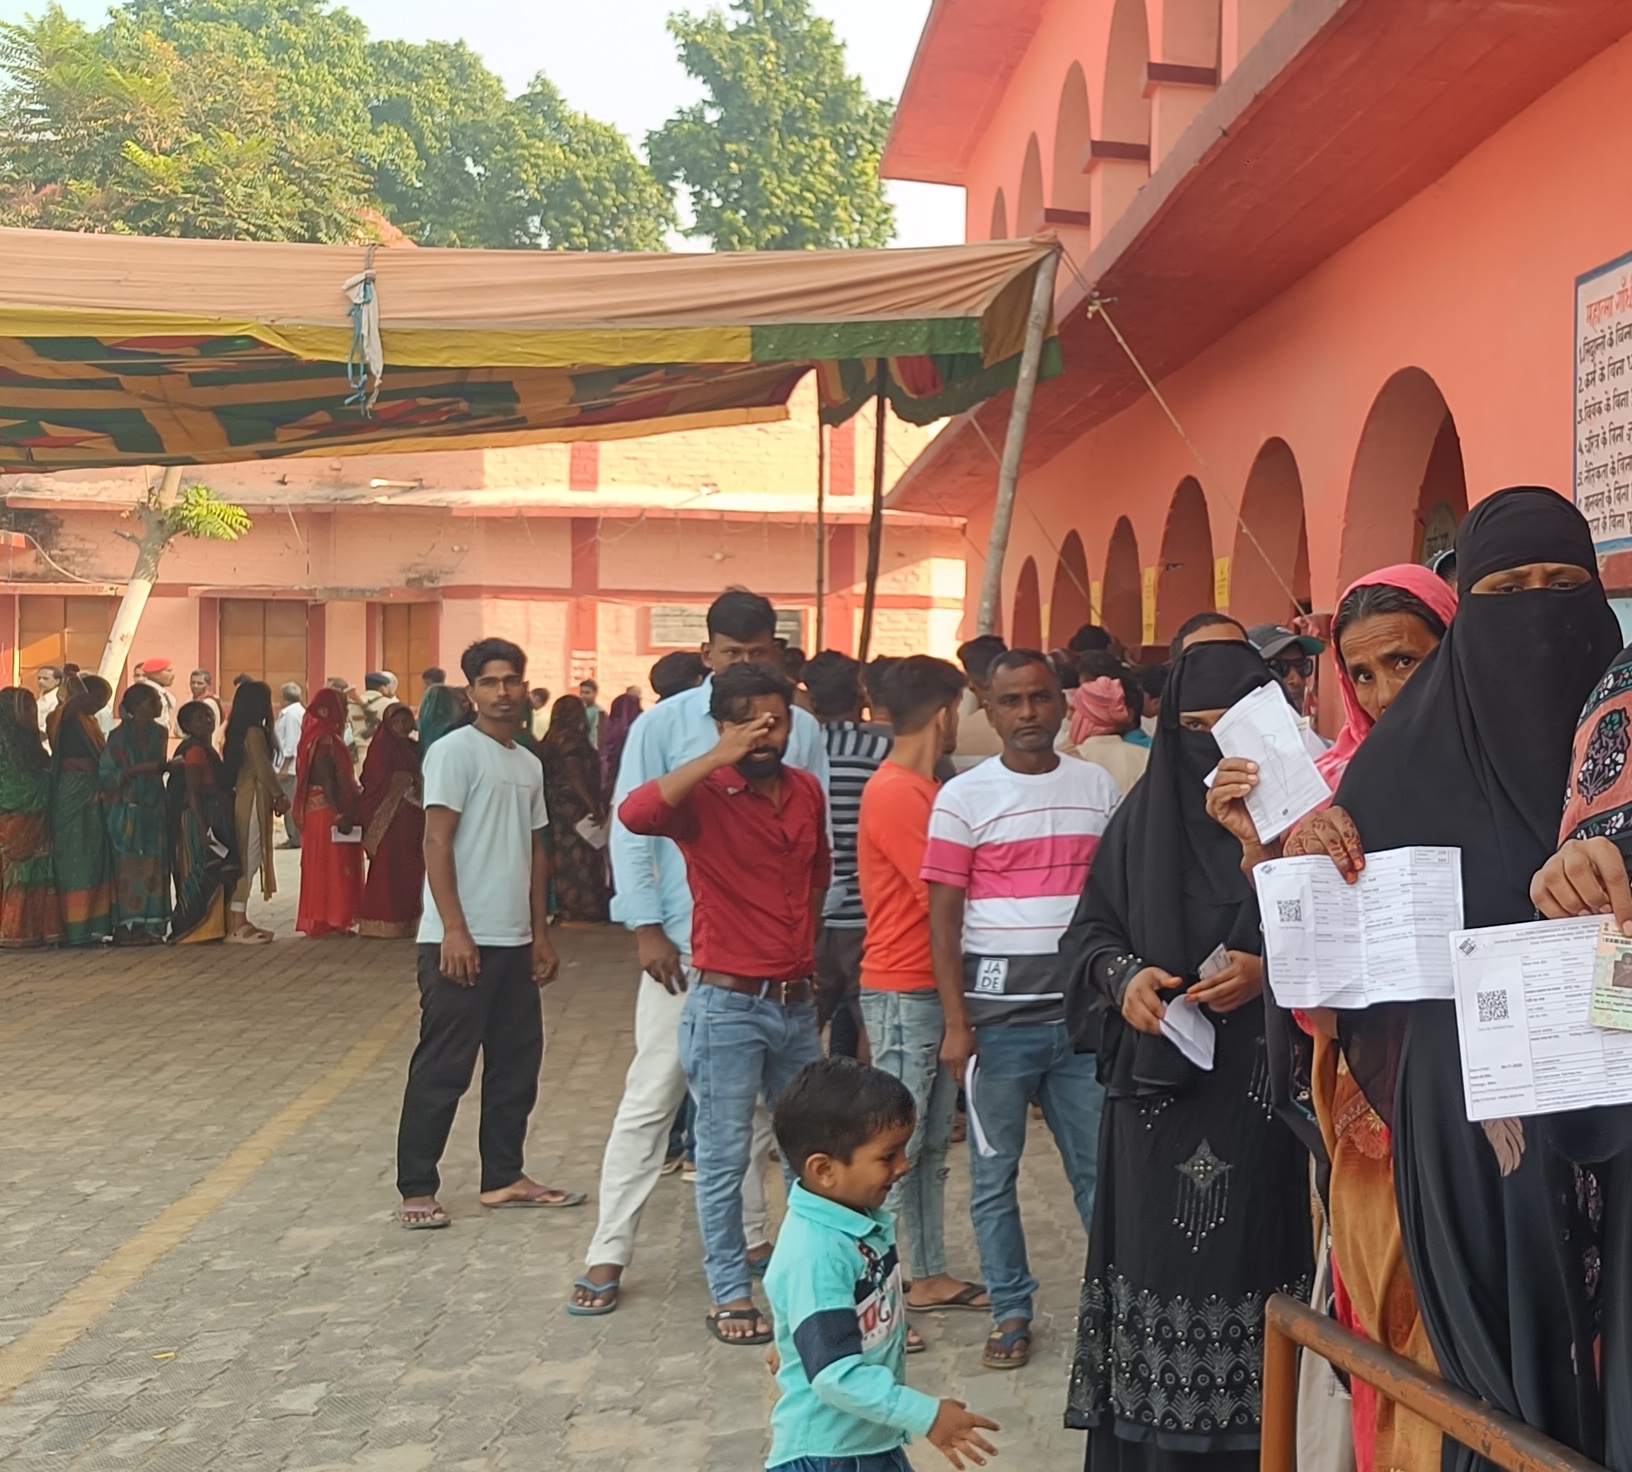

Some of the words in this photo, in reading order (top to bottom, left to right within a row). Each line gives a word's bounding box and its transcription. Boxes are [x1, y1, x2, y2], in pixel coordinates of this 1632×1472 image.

[1586, 295, 1614, 332] महात्मा
[1606, 325, 1615, 348] के
[1615, 321, 1632, 347] बिना
[1598, 360, 1606, 383] के
[1607, 356, 1626, 381] बिना
[1604, 390, 1612, 413] के
[1612, 387, 1630, 412] बिना
[1600, 425, 1608, 450] के
[1608, 421, 1625, 446] बिना
[1609, 454, 1617, 479] के
[1605, 482, 1613, 508] के
[1613, 480, 1630, 505] बिना
[1600, 510, 1608, 534] के
[1608, 508, 1626, 532] बिना
[983, 961, 1001, 975] JA
[981, 976, 1000, 989] DE
